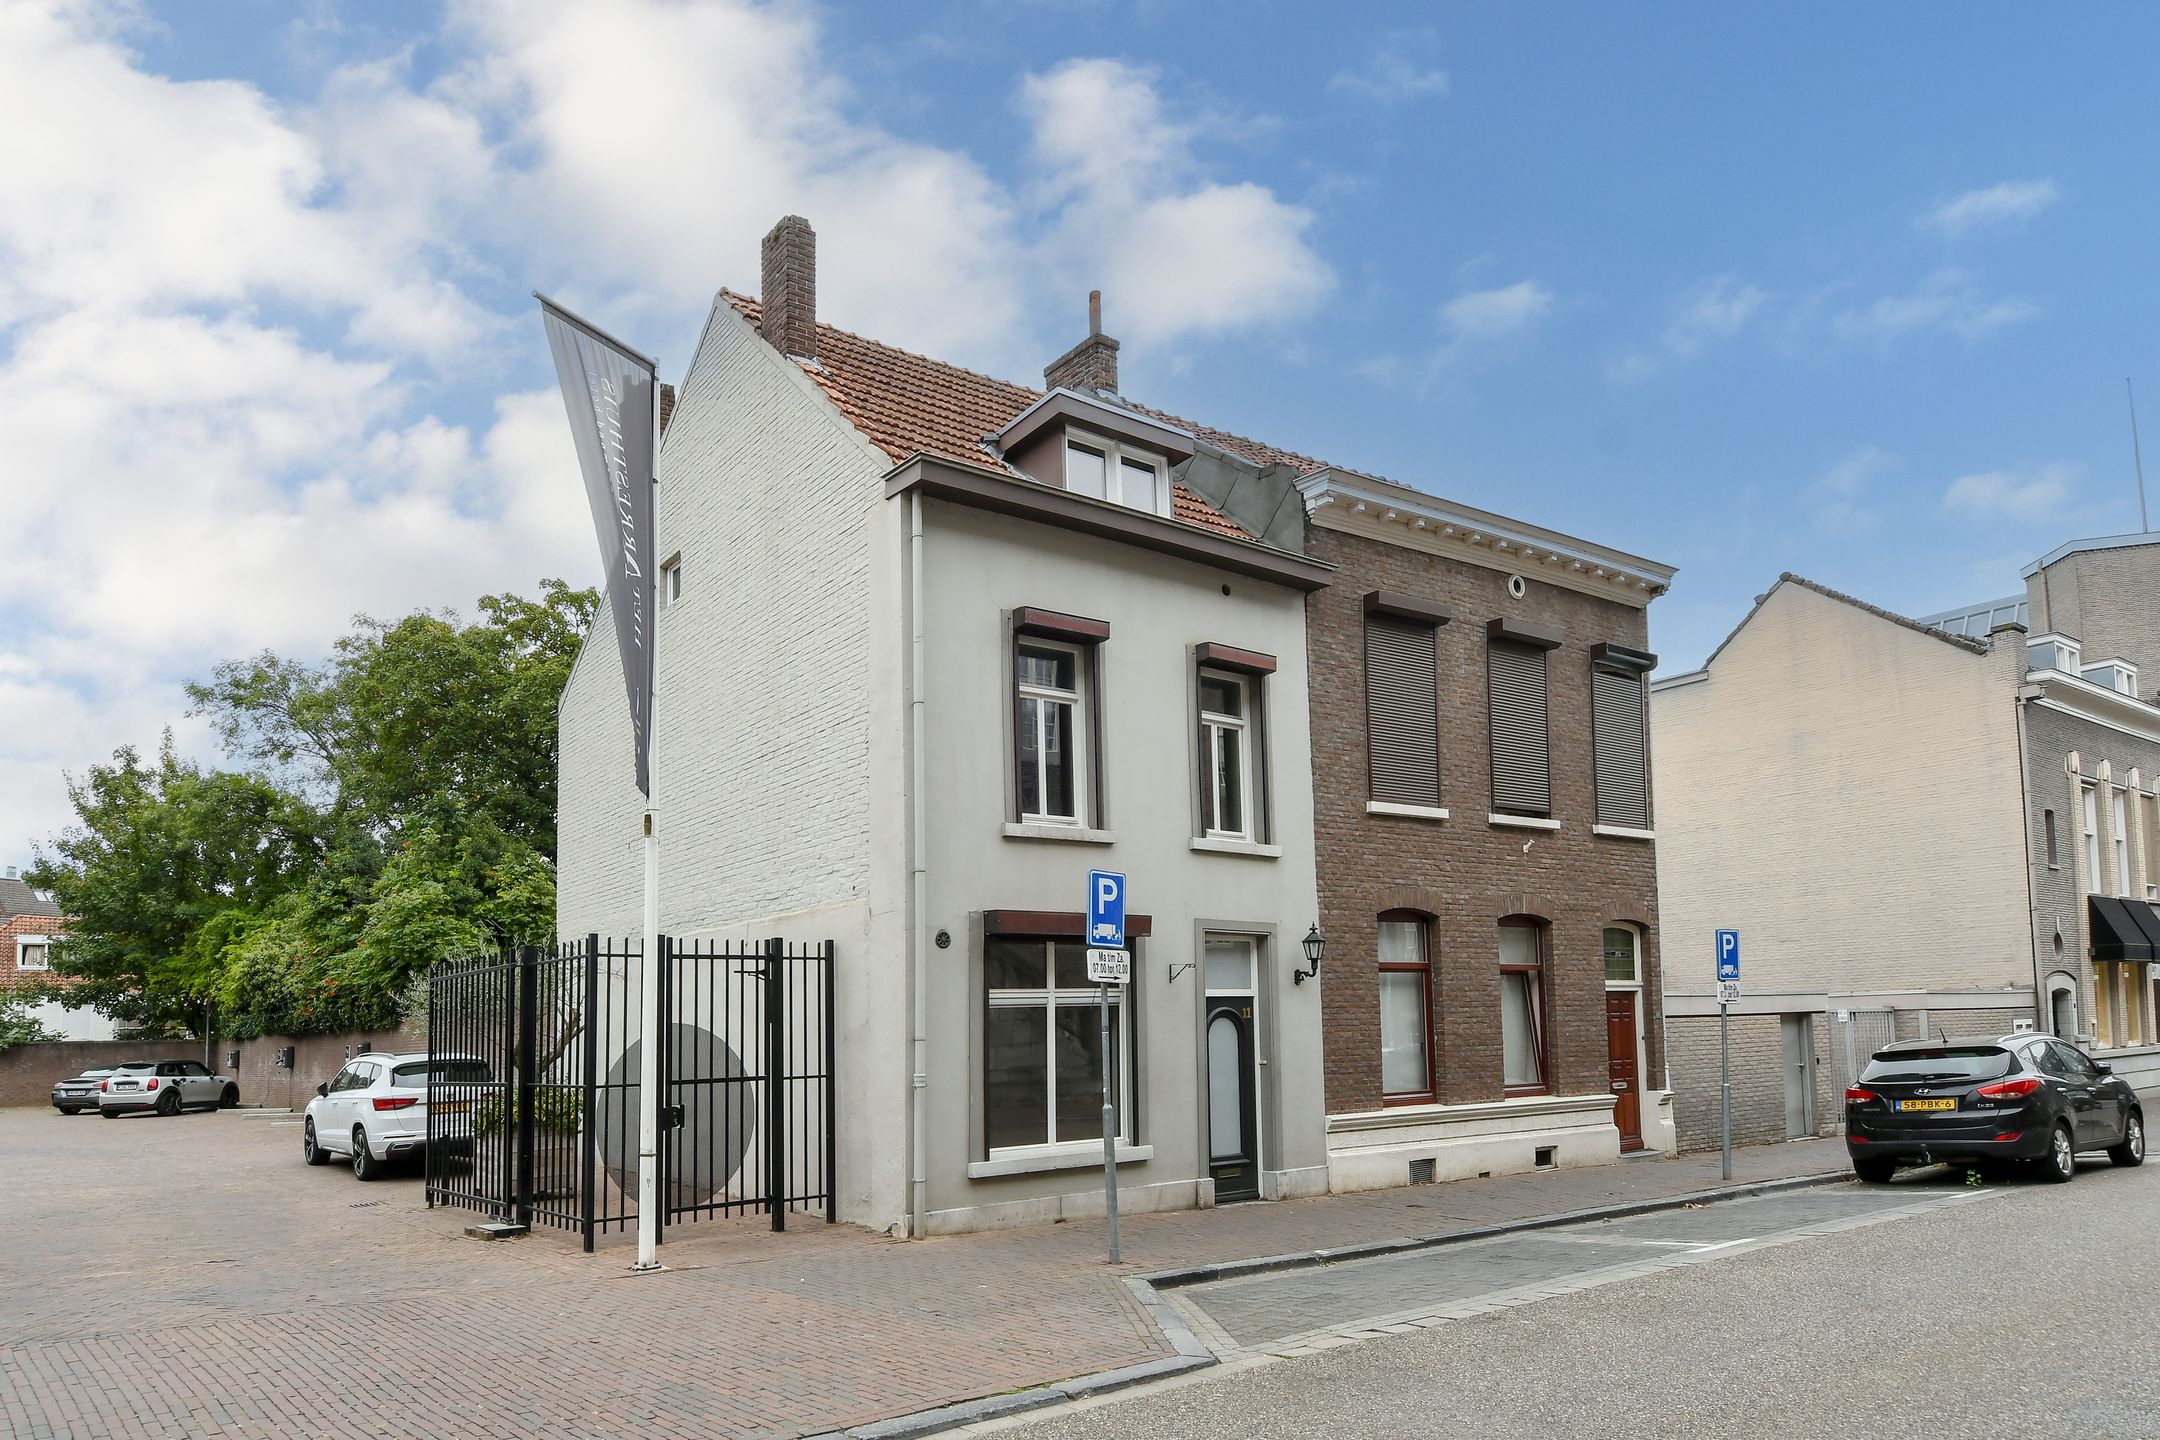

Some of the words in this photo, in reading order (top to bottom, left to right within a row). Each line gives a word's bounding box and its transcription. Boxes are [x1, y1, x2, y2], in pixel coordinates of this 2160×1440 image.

[1098, 877, 1118, 915] P
[1722, 934, 1735, 959] P
[1098, 951, 1107, 962] Ma
[1242, 1007, 1252, 1018] 11
[1903, 1100, 1952, 1109] 58-PBK-6
